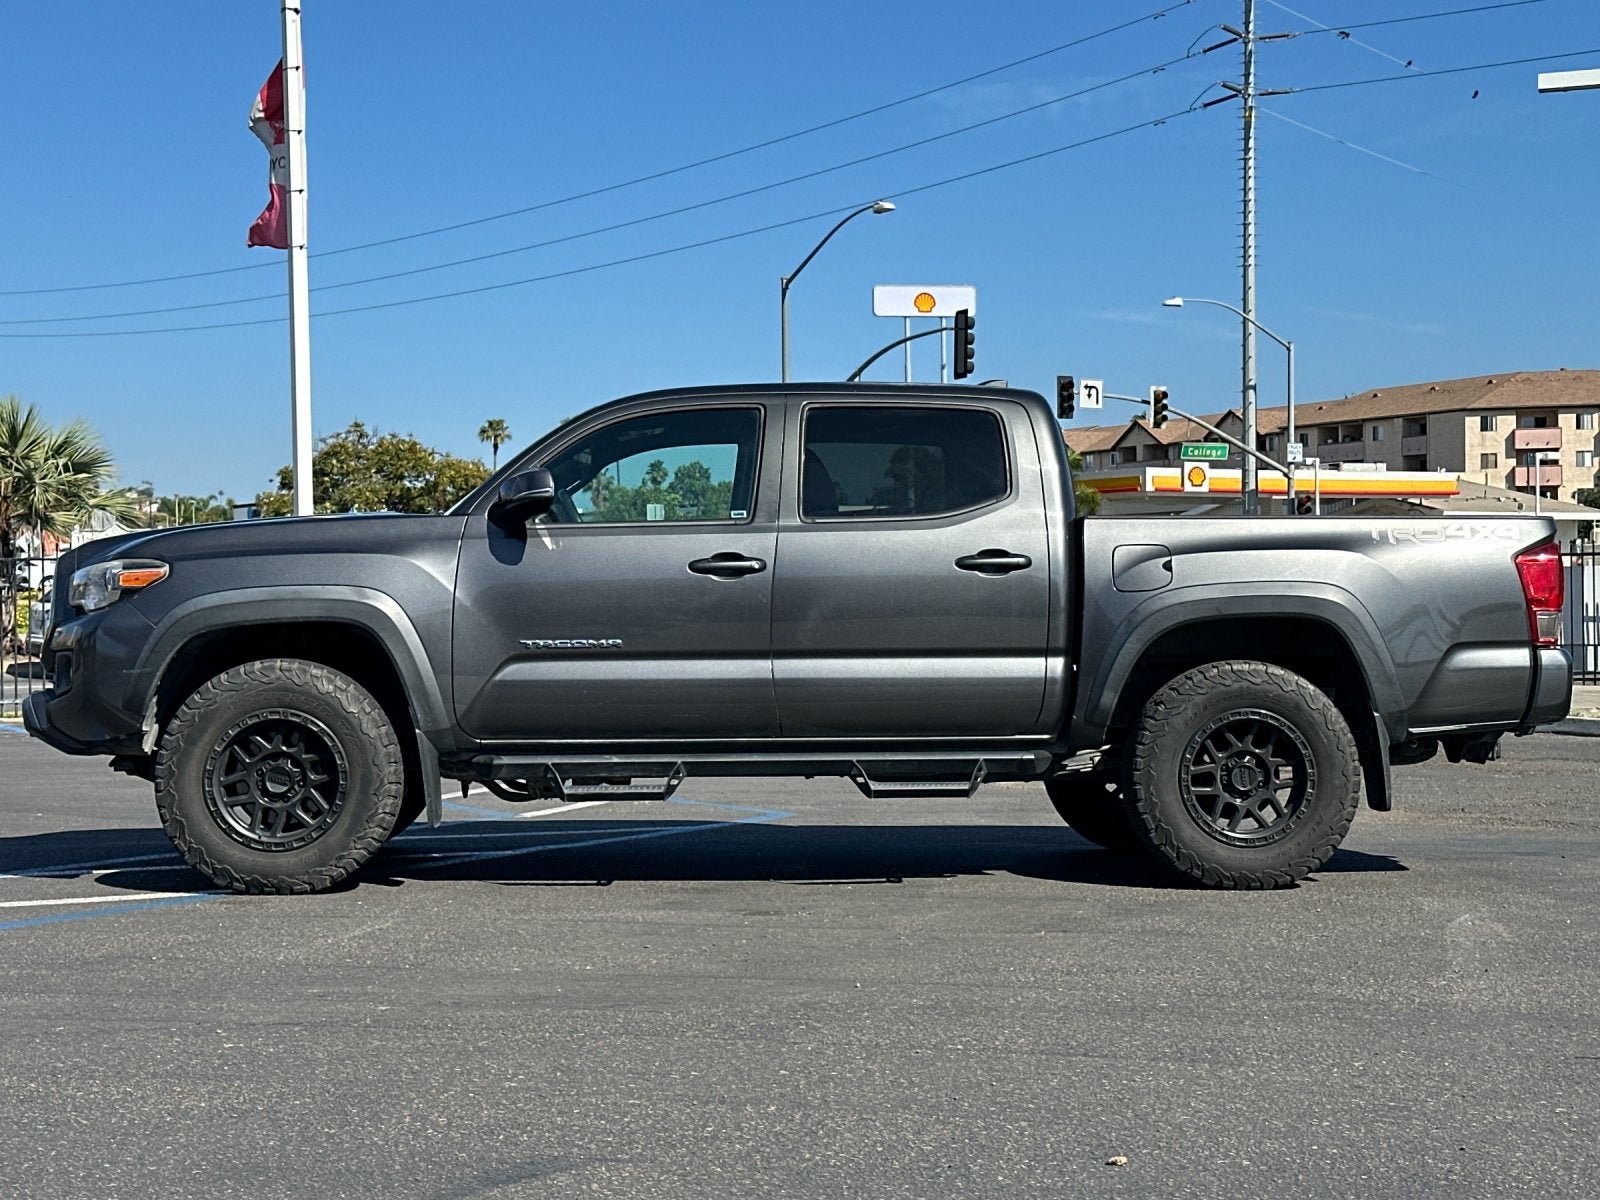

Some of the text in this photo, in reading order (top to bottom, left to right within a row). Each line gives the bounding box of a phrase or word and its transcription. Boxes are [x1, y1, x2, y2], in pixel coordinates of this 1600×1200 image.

[1188, 448, 1222, 457] College
[1369, 524, 1447, 546] TRD
[519, 639, 623, 649] TACOMA
